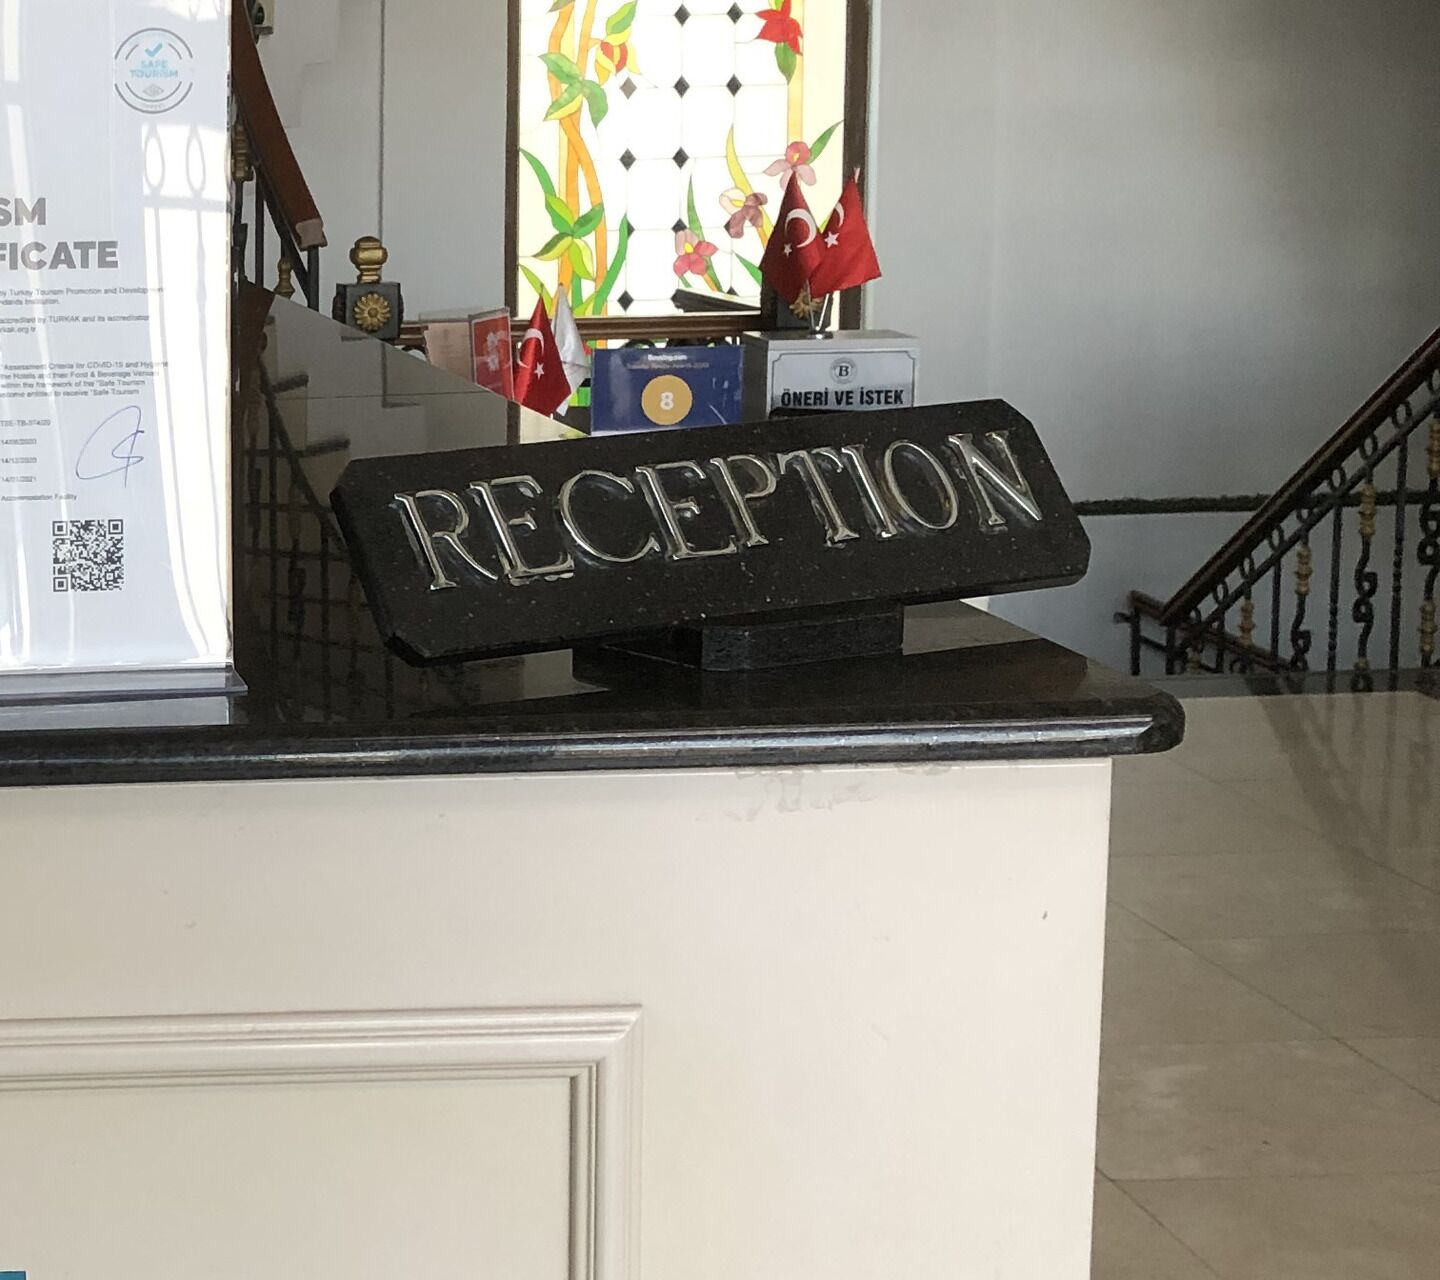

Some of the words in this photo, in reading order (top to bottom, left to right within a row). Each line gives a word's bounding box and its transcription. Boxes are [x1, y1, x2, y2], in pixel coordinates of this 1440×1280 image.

[837, 364, 849, 377] B
[659, 392, 675, 410] 8
[780, 388, 829, 407] ÖNERİ
[834, 390, 853, 406] VE
[859, 387, 905, 405] İSTEK
[394, 430, 1042, 591] RECEPTION
